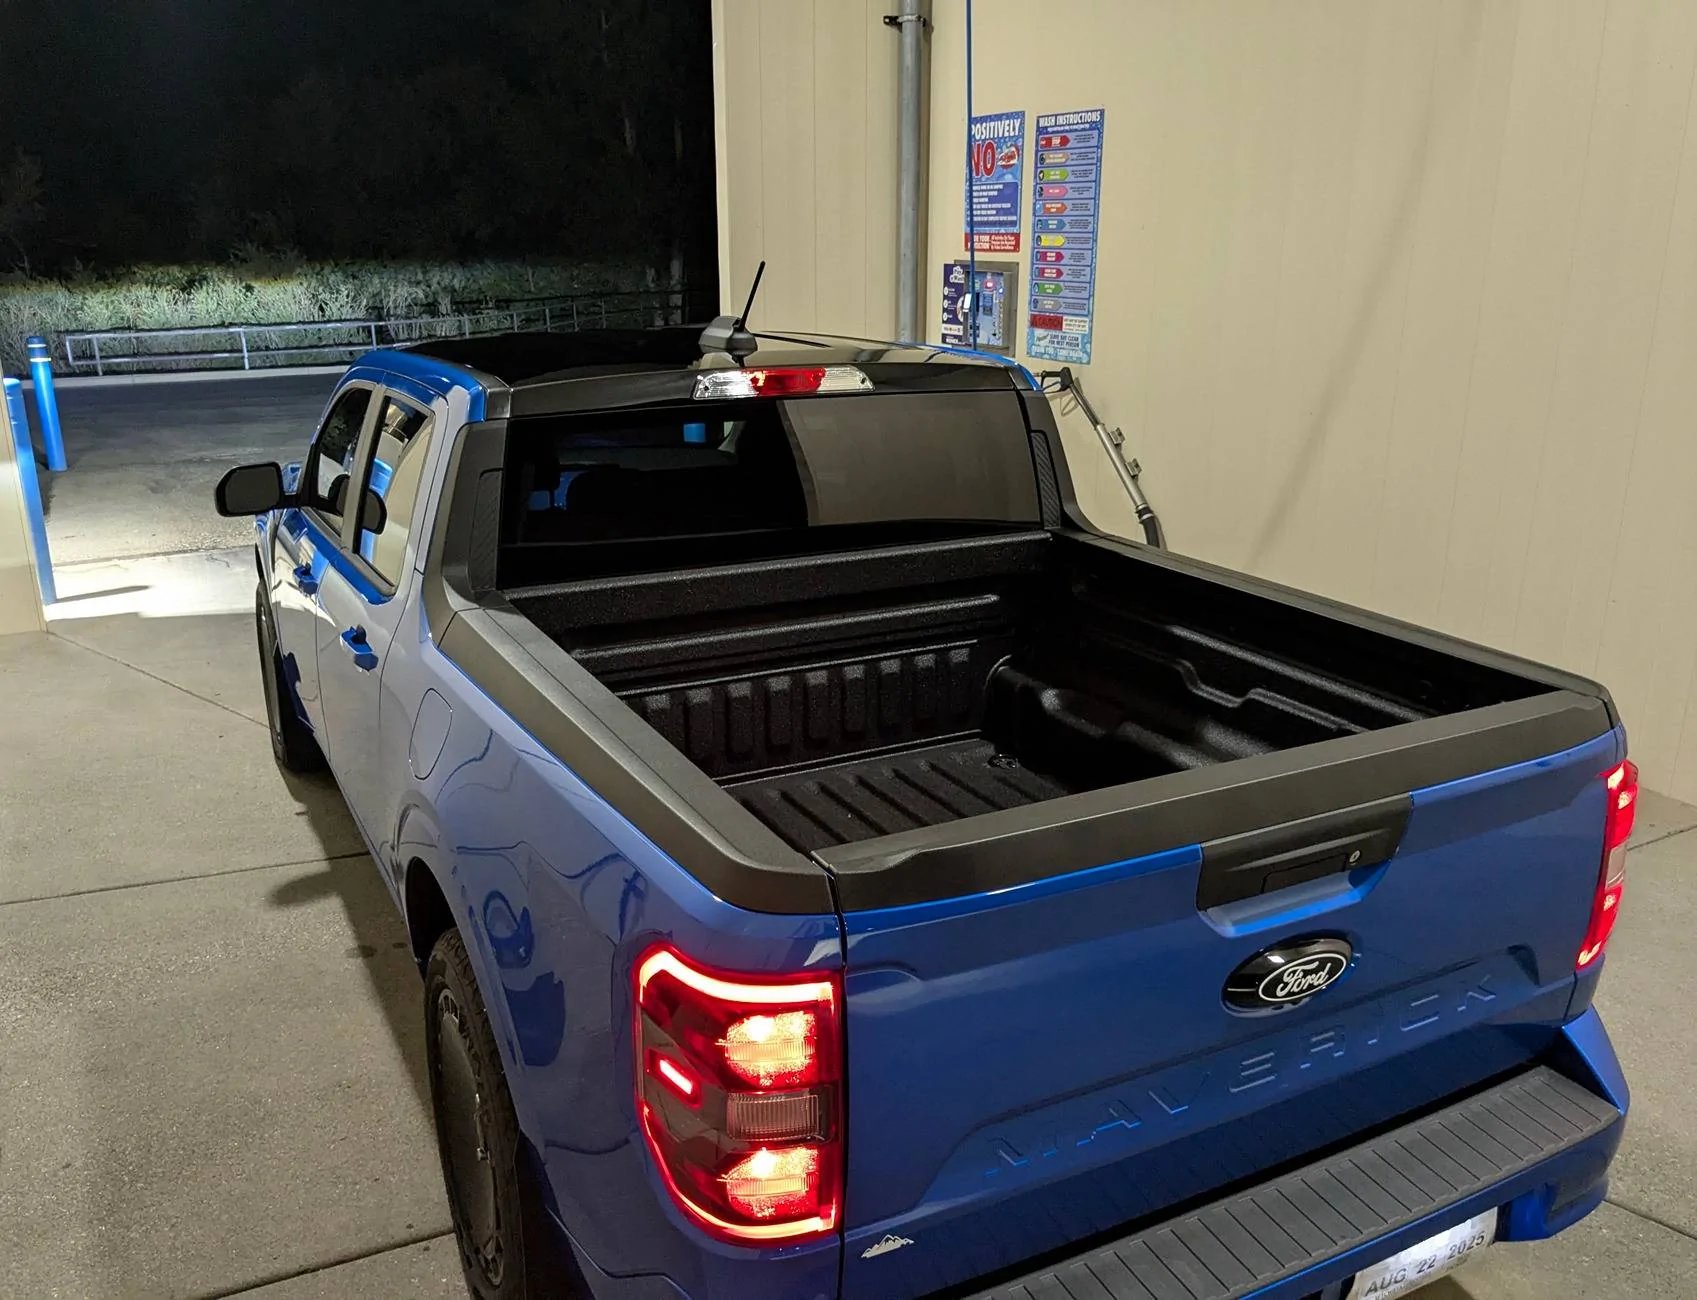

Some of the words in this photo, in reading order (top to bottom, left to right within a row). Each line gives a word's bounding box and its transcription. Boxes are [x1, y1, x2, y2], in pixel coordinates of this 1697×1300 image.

[1039, 115, 1056, 127] WASH
[1056, 111, 1101, 126] INSTRUCTIONS
[1276, 961, 1332, 997] Ford
[985, 974, 1497, 1177] MAVERICK
[1365, 1268, 1408, 1297] AUG
[1416, 1254, 1437, 1275] 22
[1447, 1230, 1486, 1260] 2025
